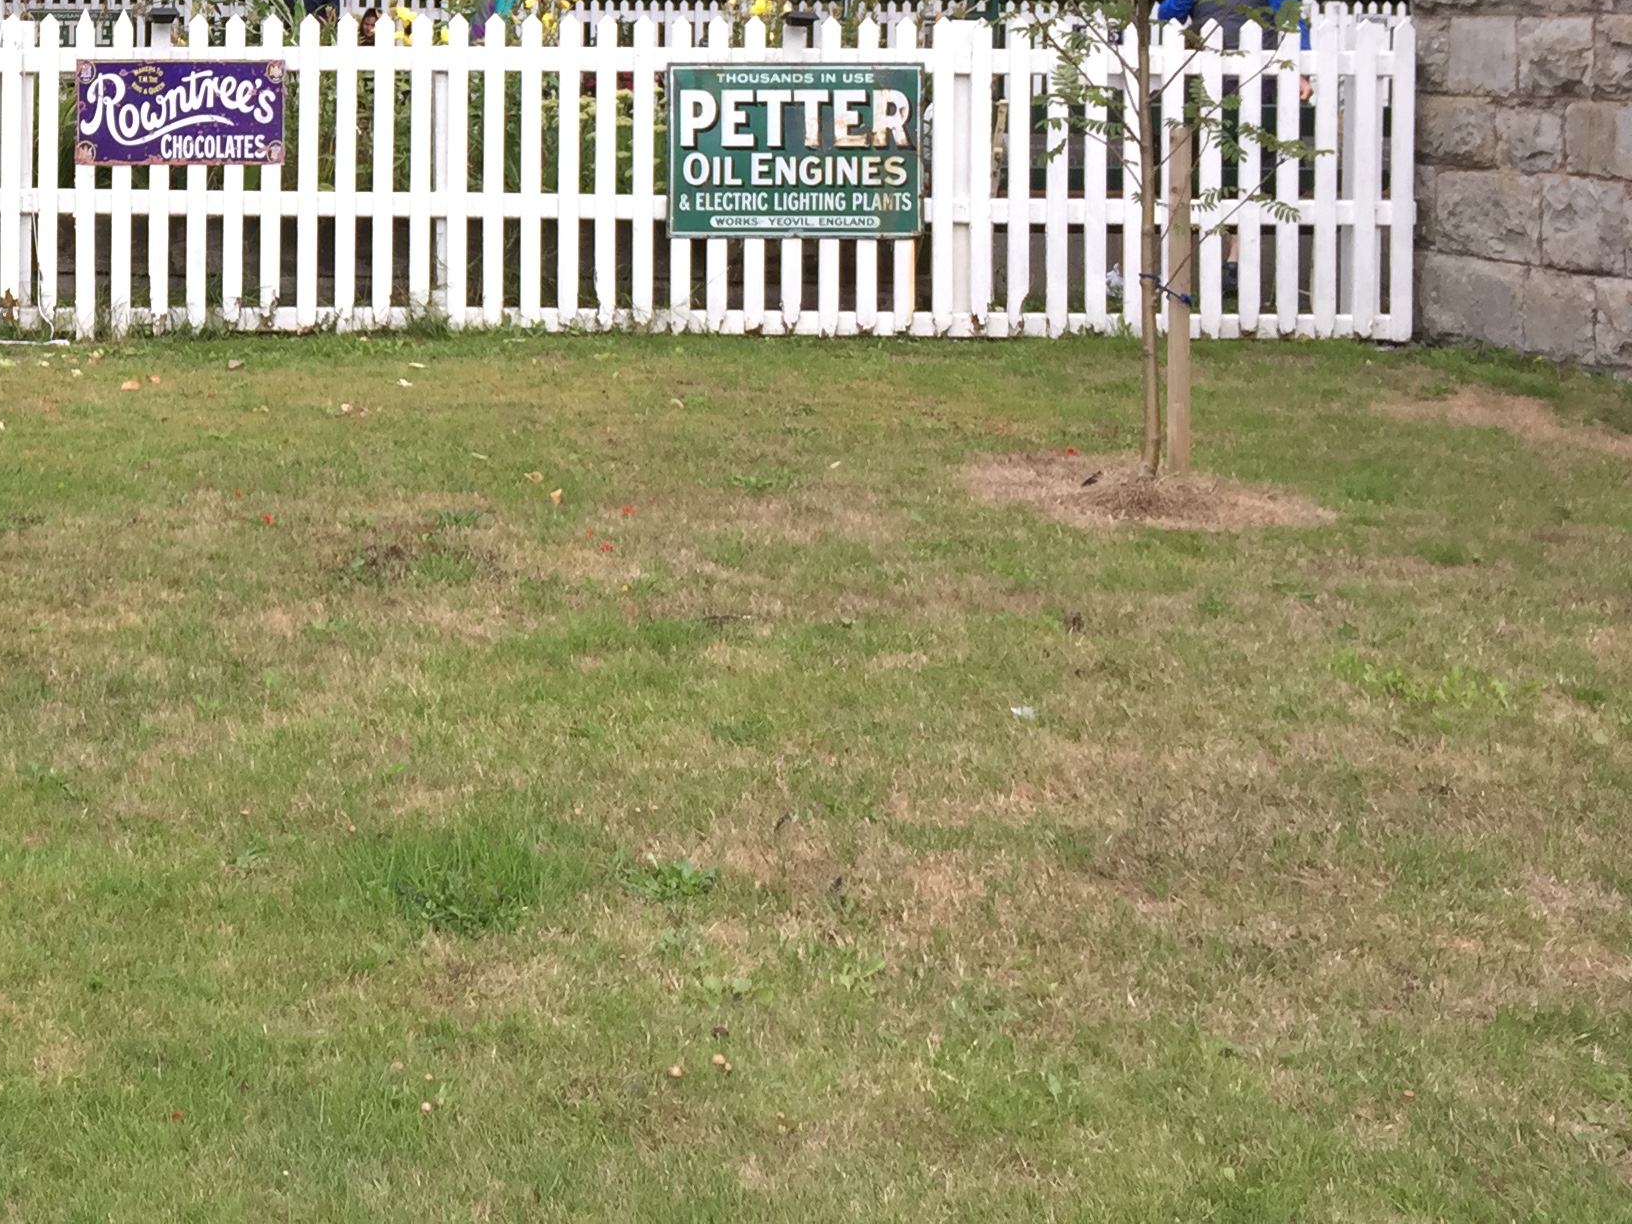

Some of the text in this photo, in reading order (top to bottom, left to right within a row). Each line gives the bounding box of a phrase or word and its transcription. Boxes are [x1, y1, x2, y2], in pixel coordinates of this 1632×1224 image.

[716, 72, 875, 84] THOUSANDS IN USE
[80, 70, 276, 146] Rowntree's
[679, 89, 911, 149] PETTER
[160, 134, 267, 159] CHOCOLATES
[682, 152, 908, 187] OIL ENGINES
[679, 192, 912, 212] & ELECTRIC LIGHTING PLANTS
